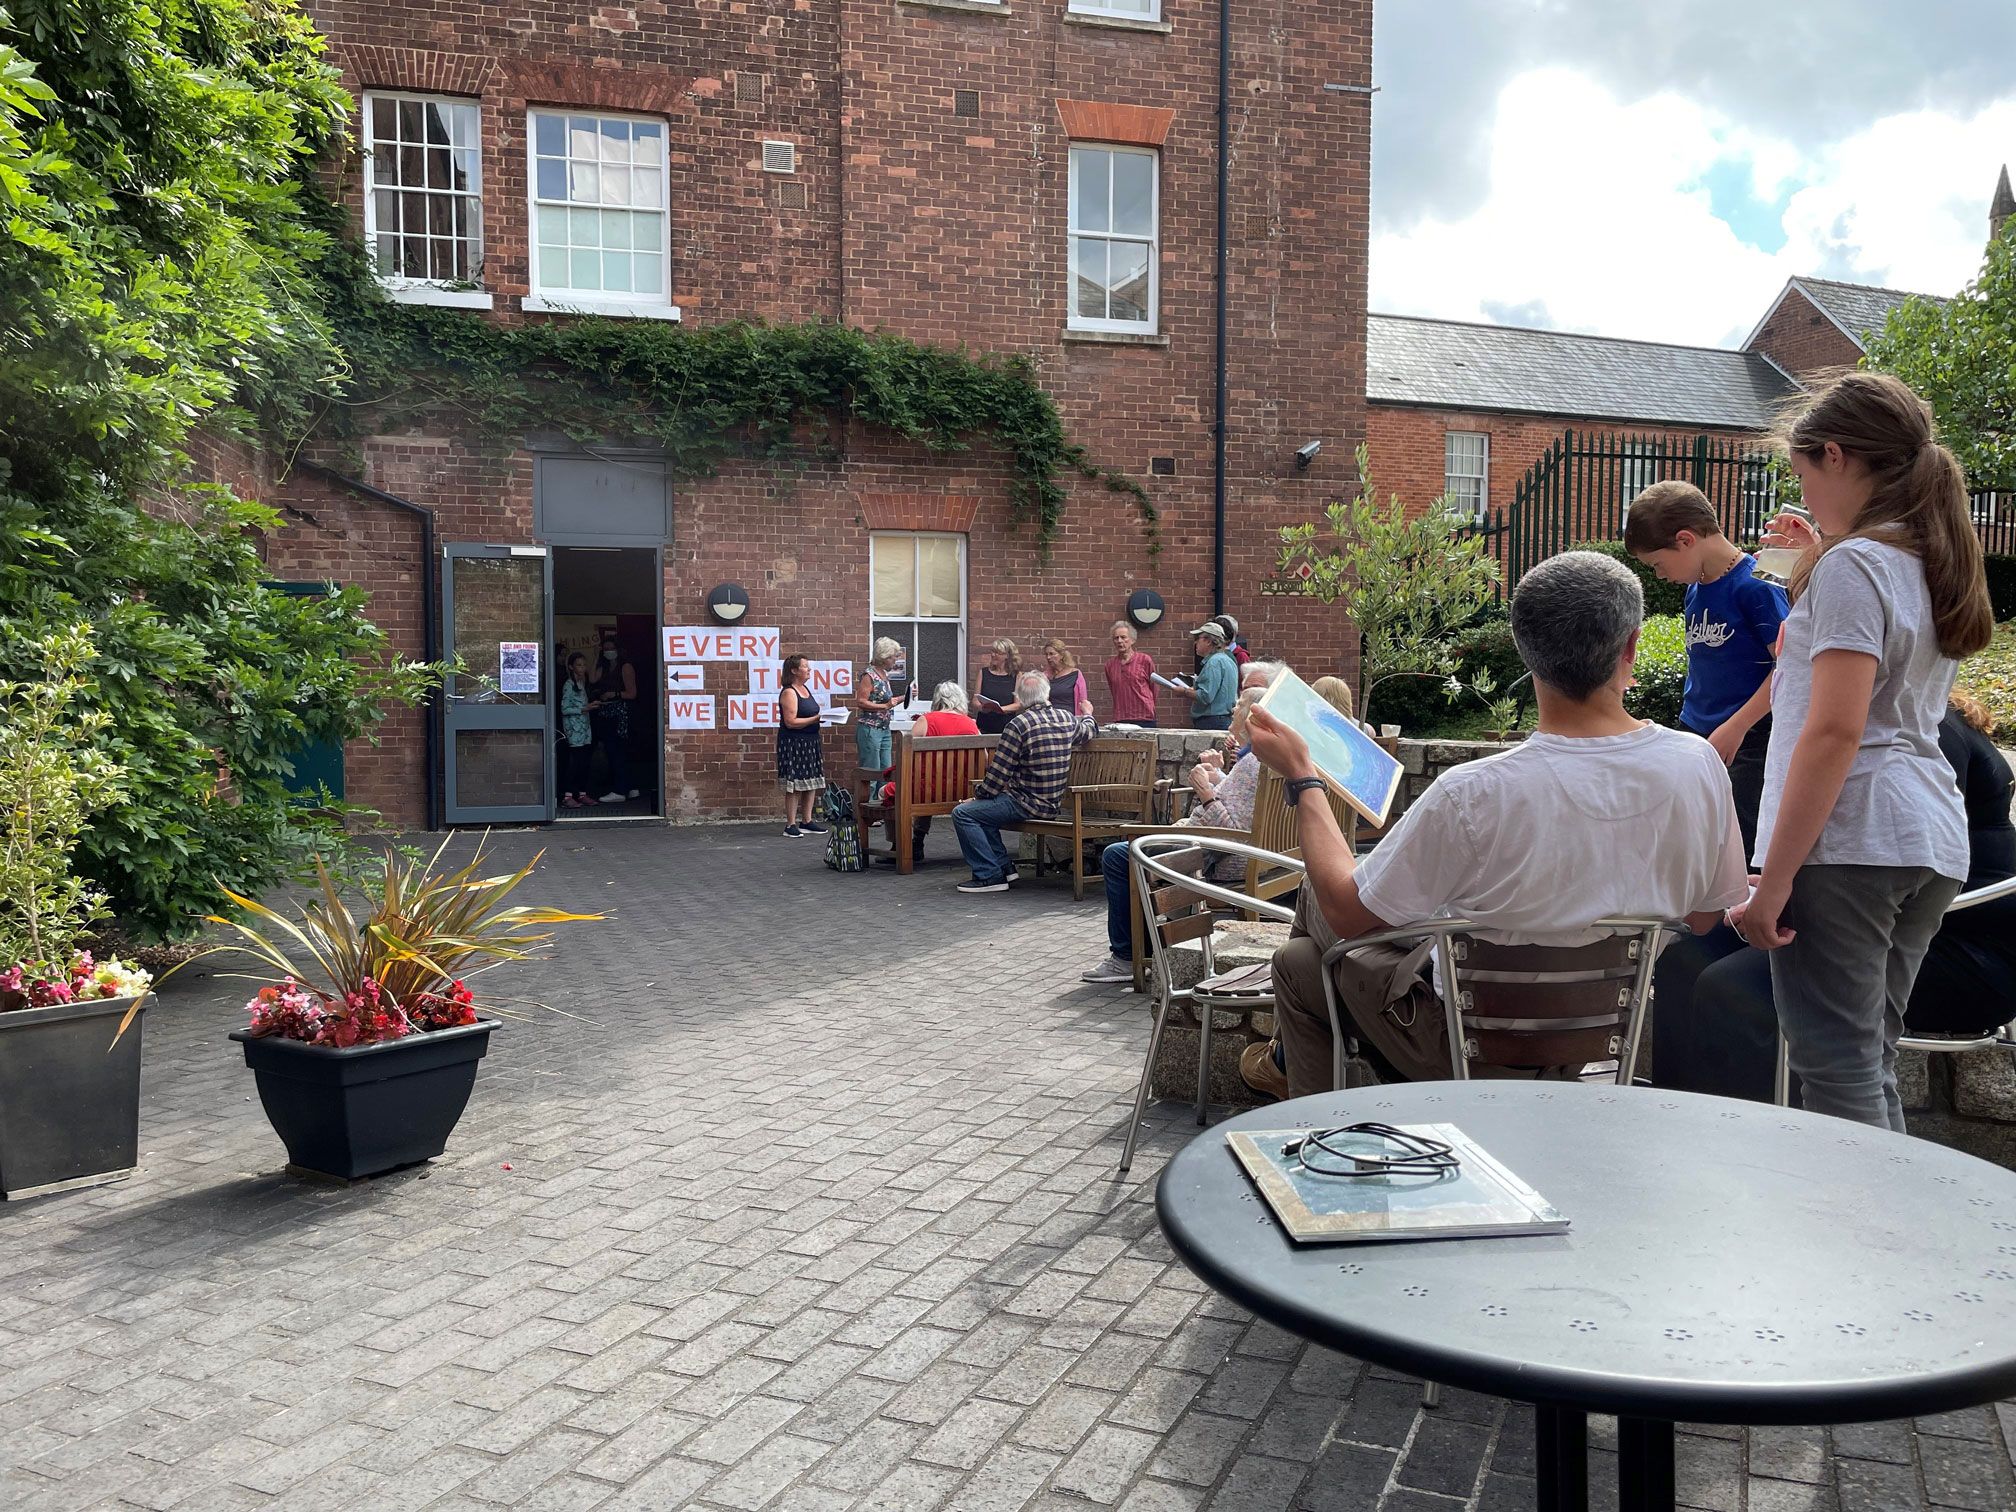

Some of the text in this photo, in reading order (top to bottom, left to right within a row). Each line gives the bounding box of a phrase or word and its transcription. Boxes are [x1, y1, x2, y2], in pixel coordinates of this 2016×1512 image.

[559, 633, 600, 647] HING
[669, 635, 778, 657] EVERY
[753, 667, 850, 690] TNG
[673, 699, 783, 723] WE NEE
